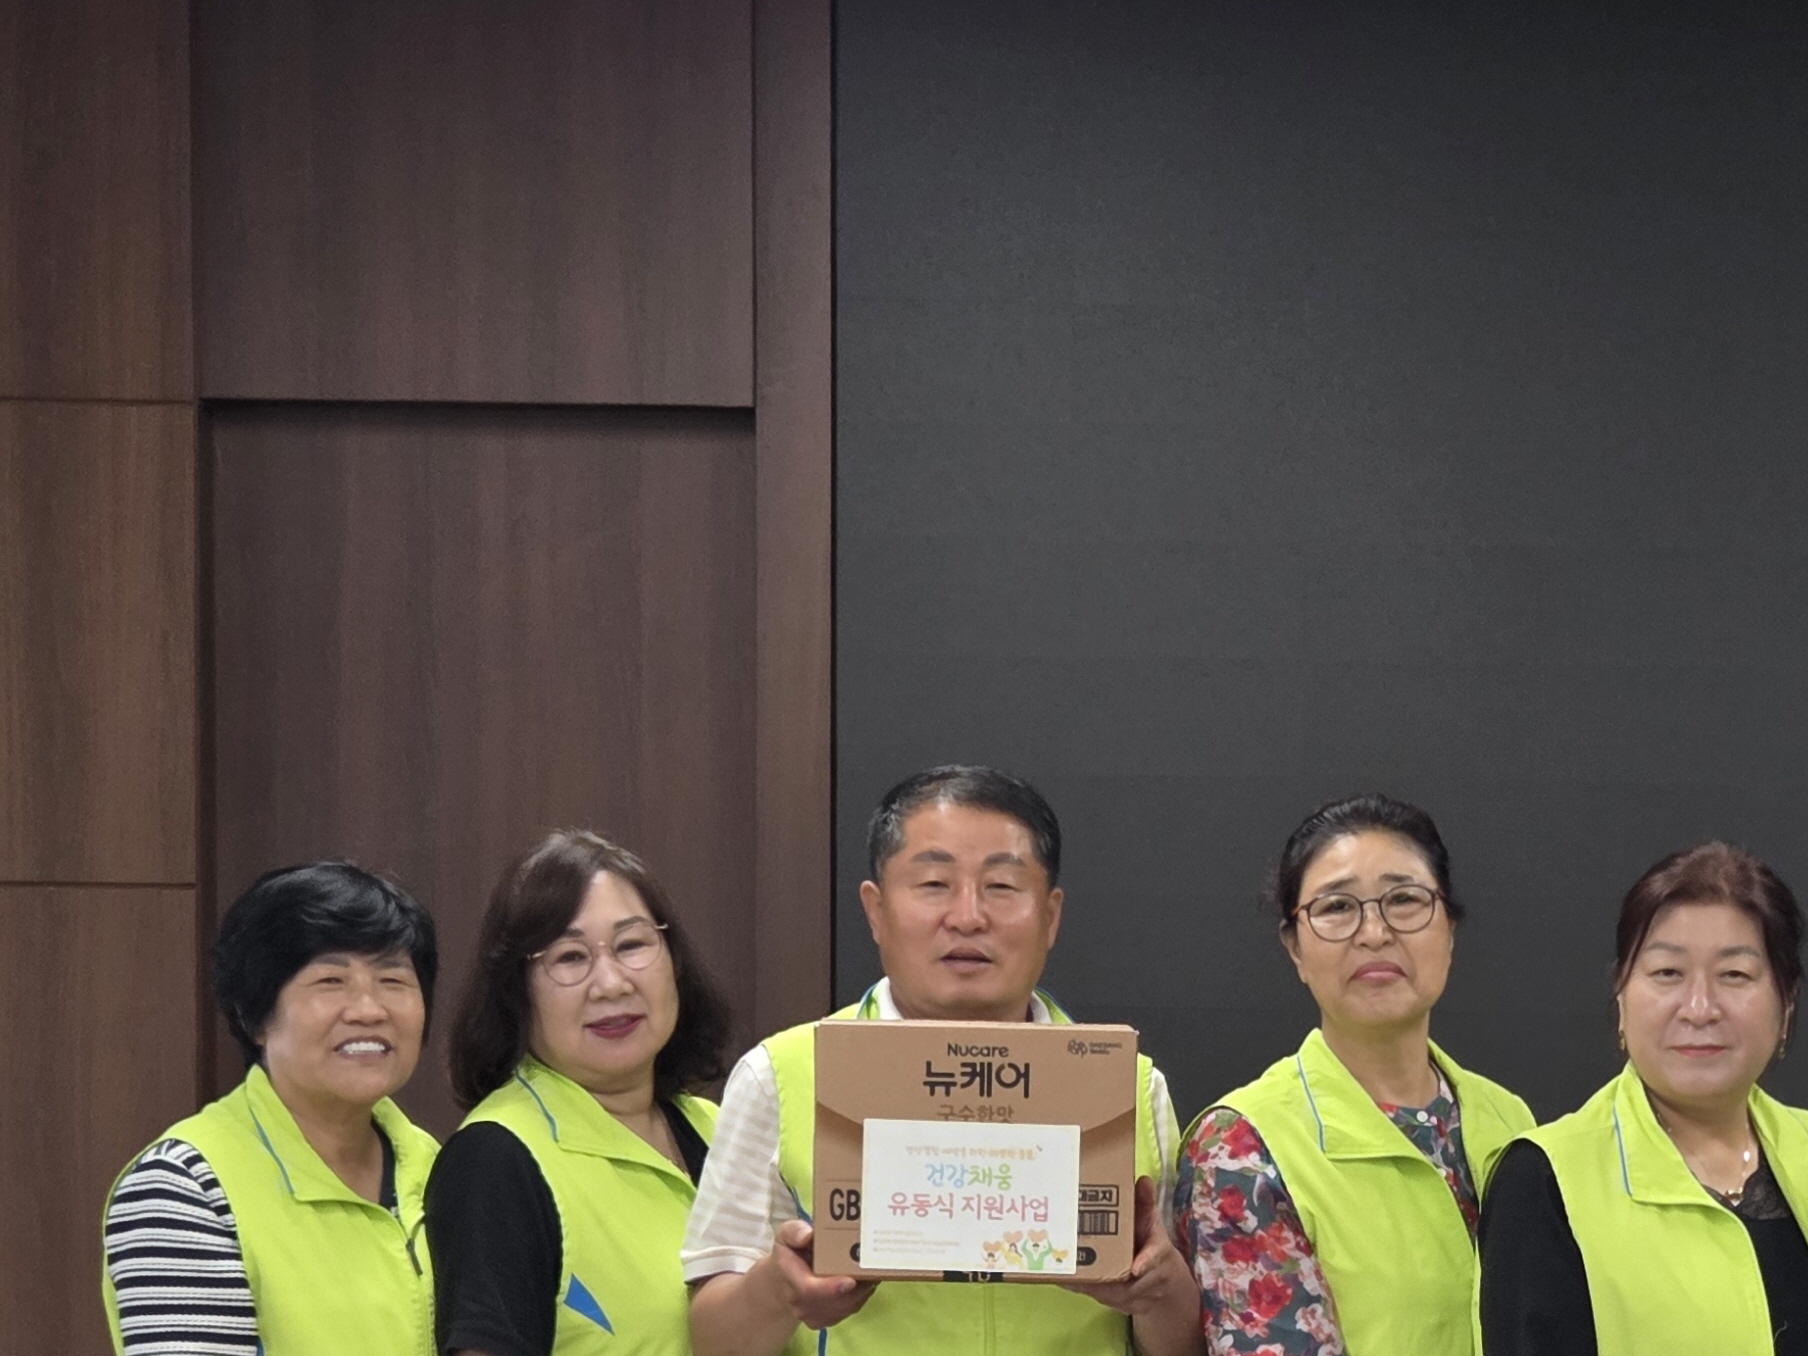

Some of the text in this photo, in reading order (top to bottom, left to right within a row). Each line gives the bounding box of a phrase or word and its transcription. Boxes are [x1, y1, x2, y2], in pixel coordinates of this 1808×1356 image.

[946, 1042, 1009, 1058] Nucare
[922, 1060, 1030, 1099] 뉴케어
[888, 1192, 1049, 1223] 유동식 지원사업
